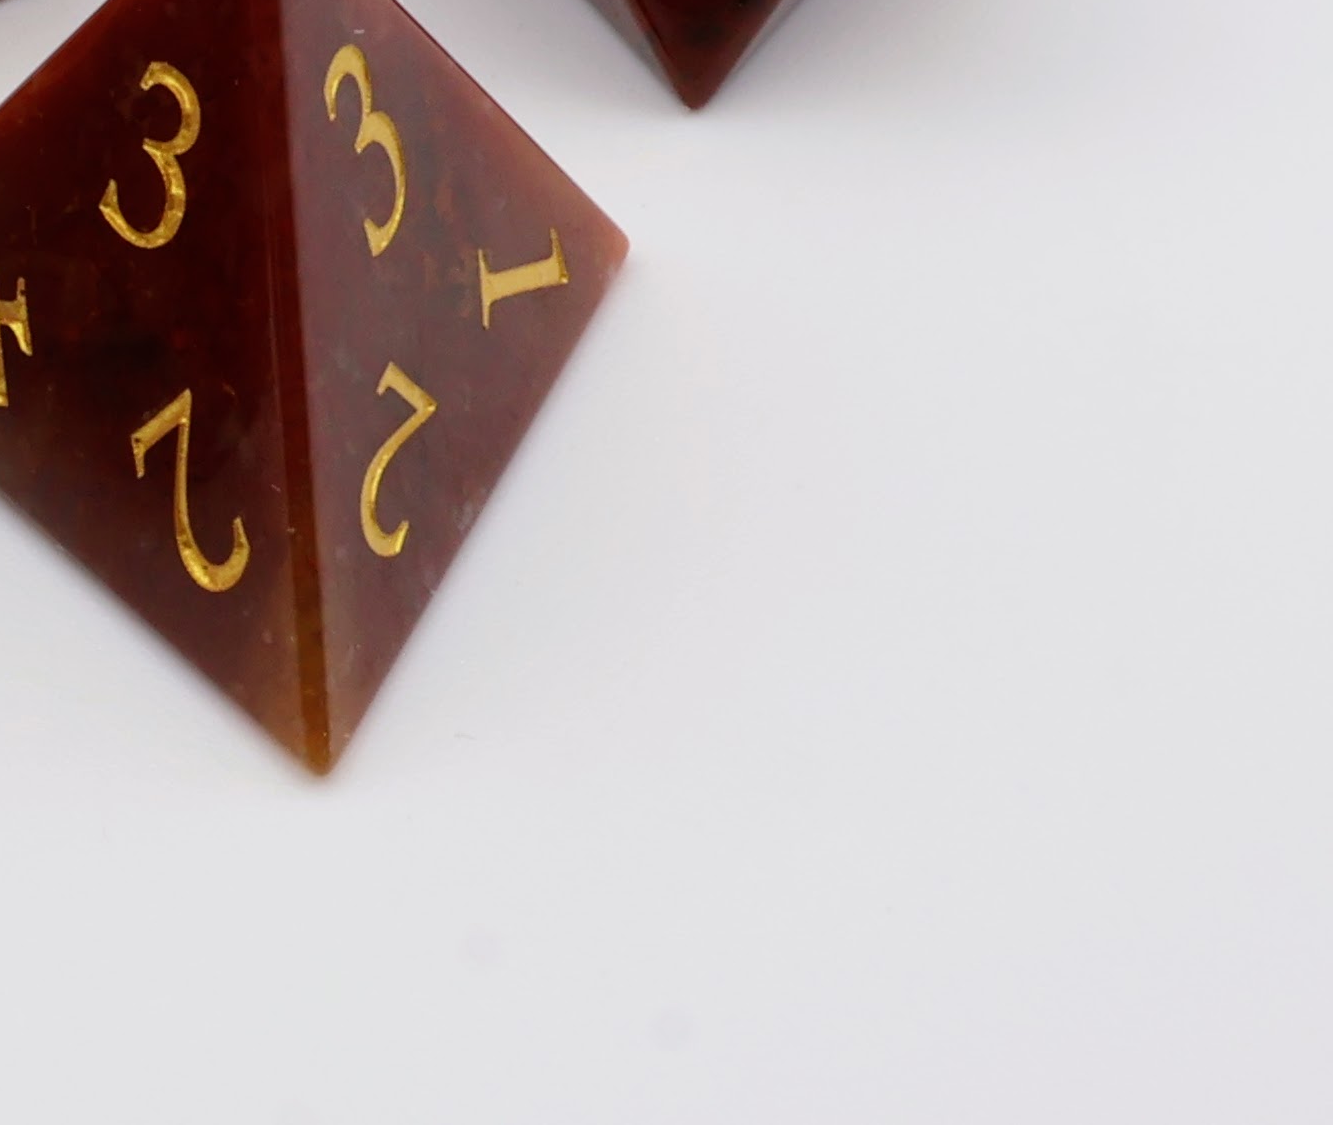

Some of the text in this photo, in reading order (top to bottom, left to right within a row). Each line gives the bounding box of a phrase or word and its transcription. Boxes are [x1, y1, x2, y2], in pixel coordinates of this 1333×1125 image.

[99, 61, 201, 250] 3
[324, 43, 407, 257] 3
[478, 227, 570, 331] 1
[132, 388, 251, 593] 2
[360, 362, 437, 558] 2
